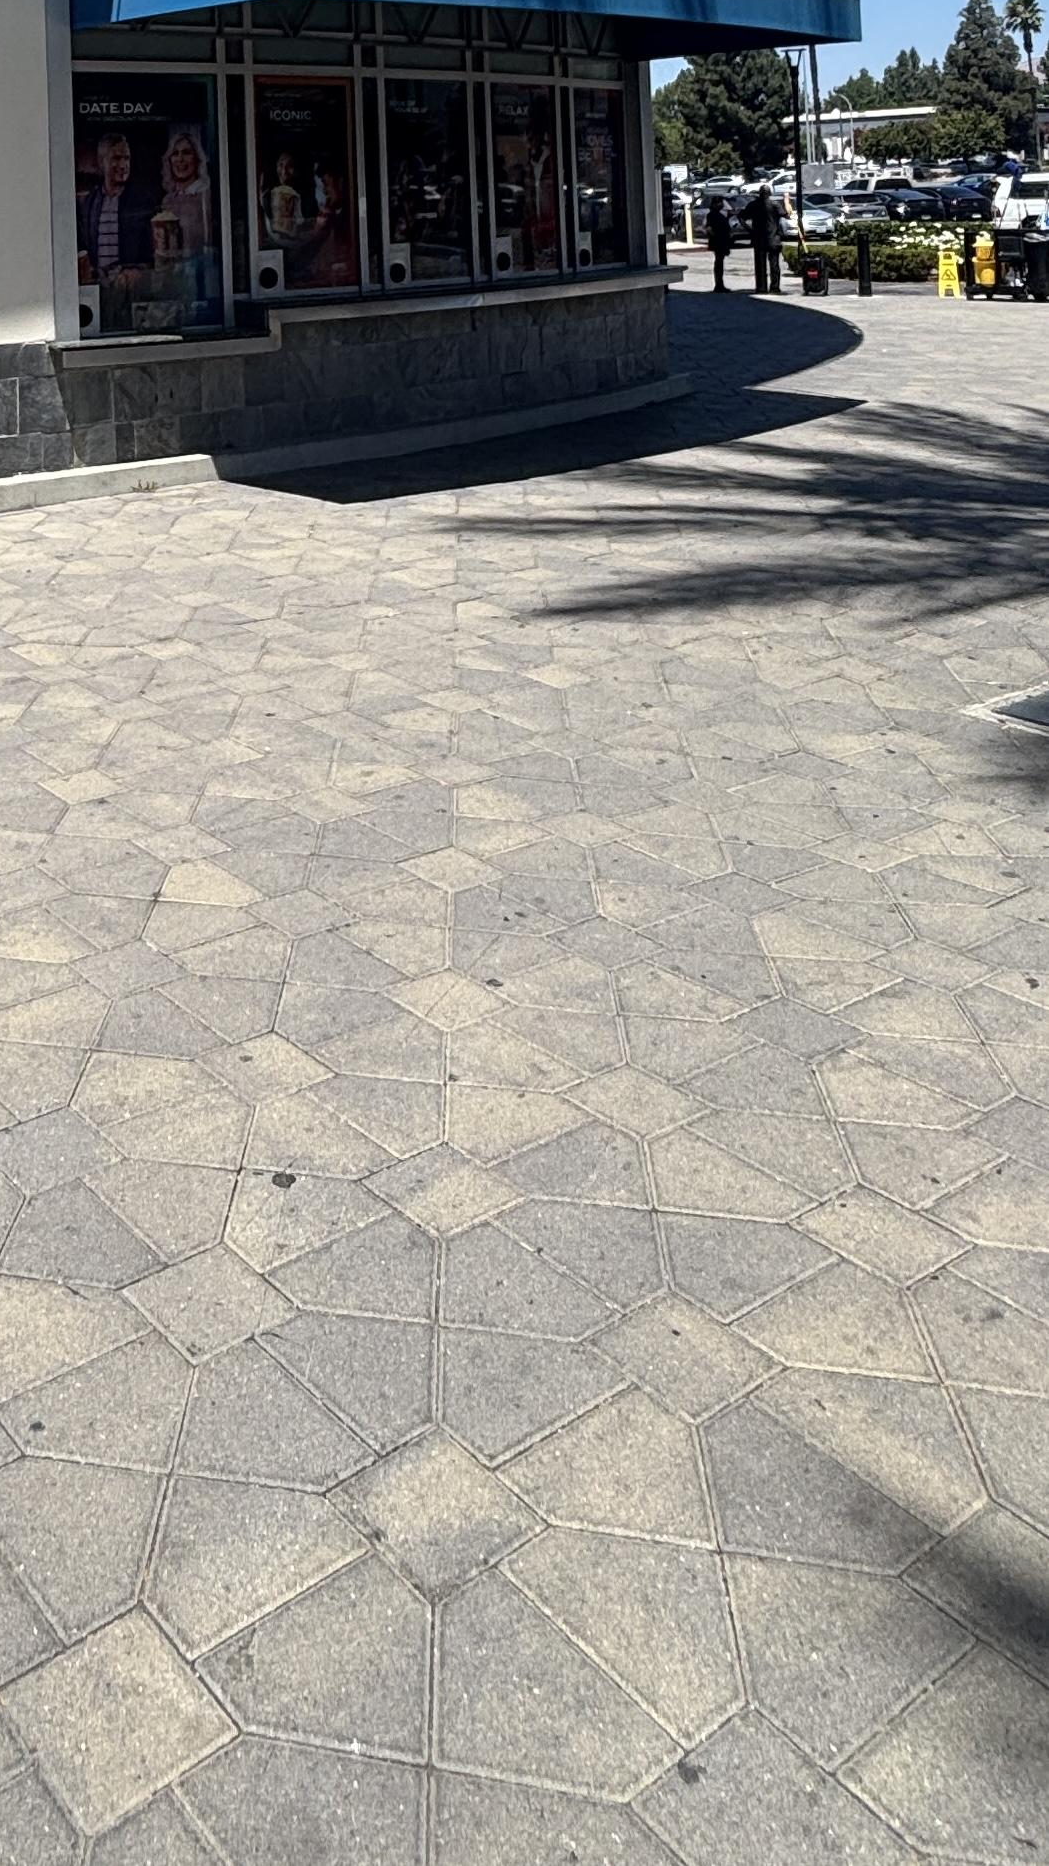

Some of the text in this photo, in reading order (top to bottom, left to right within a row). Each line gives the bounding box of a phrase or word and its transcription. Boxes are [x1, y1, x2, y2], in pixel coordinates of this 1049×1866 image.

[79, 102, 154, 114] DATE DAY
[269, 109, 312, 122] ICONIC
